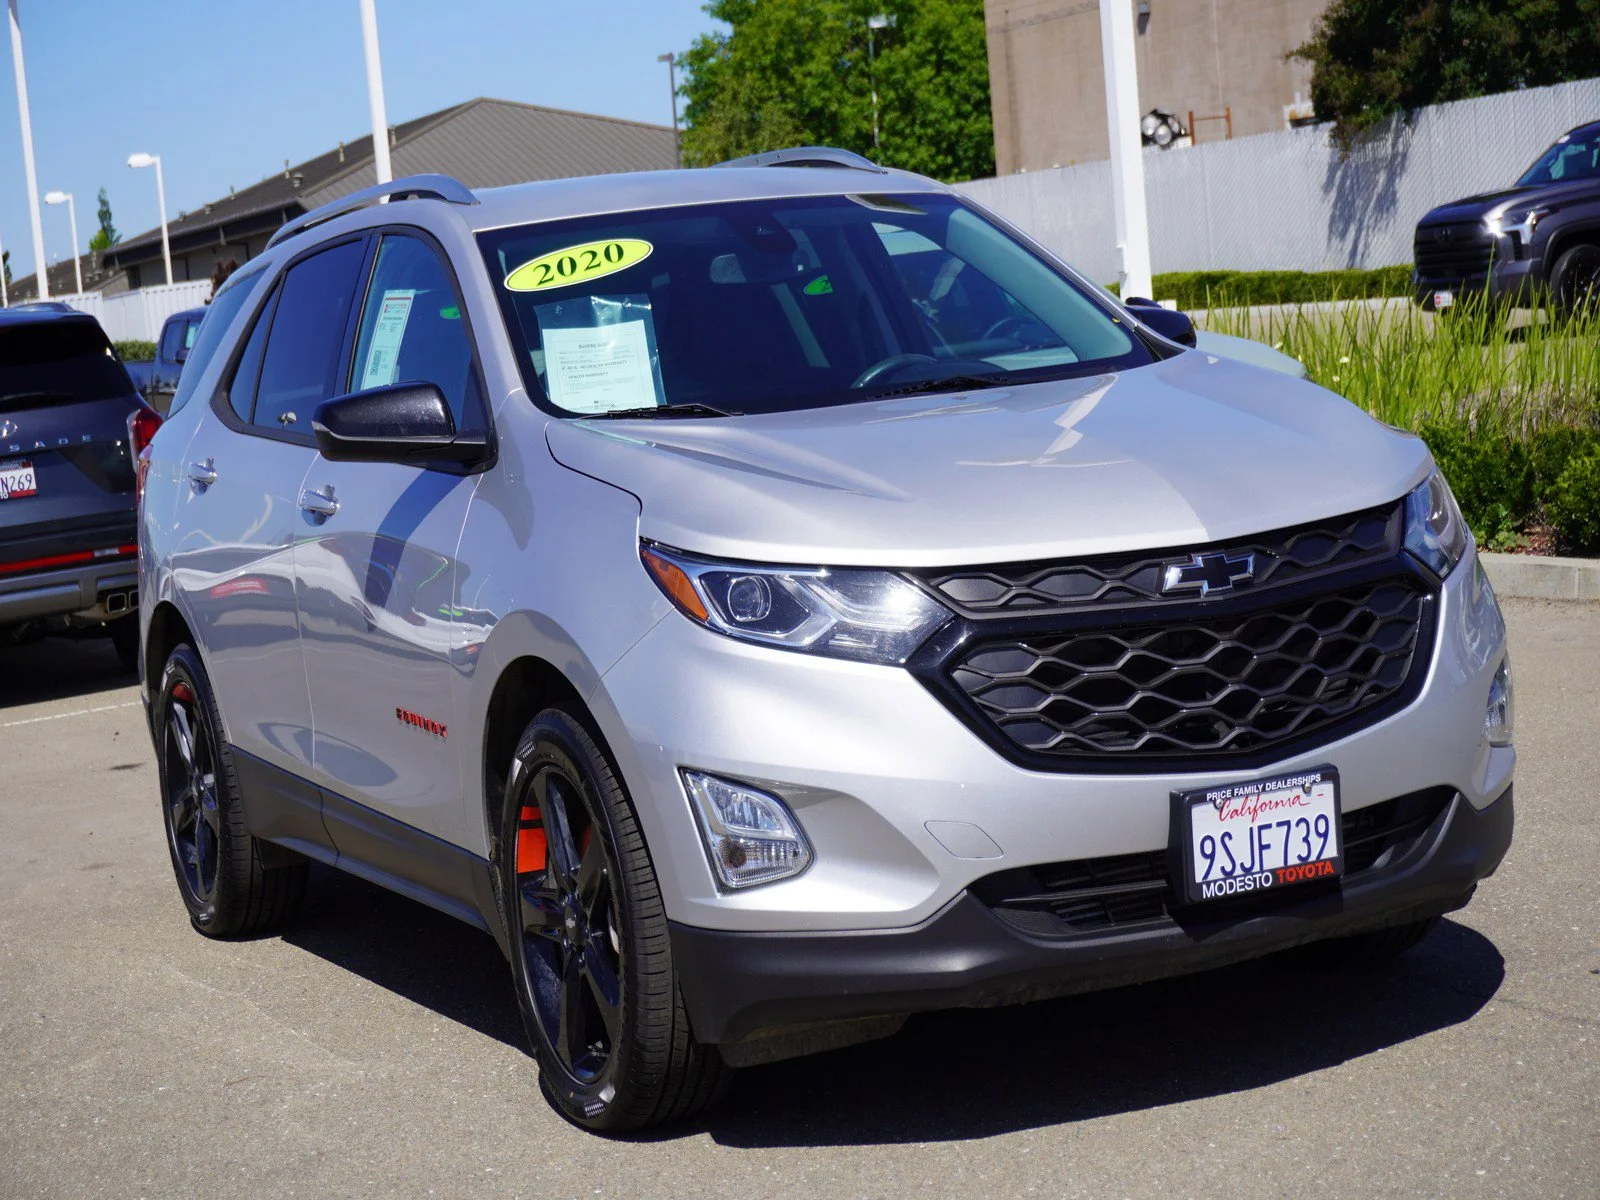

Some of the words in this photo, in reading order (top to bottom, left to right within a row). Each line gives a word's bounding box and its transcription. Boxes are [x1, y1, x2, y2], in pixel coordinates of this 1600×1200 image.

[532, 243, 624, 286] 2020
[1206, 788, 1232, 802] PRICE
[1234, 783, 1265, 798] FAMILY
[1265, 773, 1322, 791] DEALERSHIPS
[1219, 791, 1311, 823] California
[1199, 813, 1330, 881] 9SJF739
[1202, 871, 1273, 899] MODESTO
[1276, 860, 1335, 884] TOYOTA
